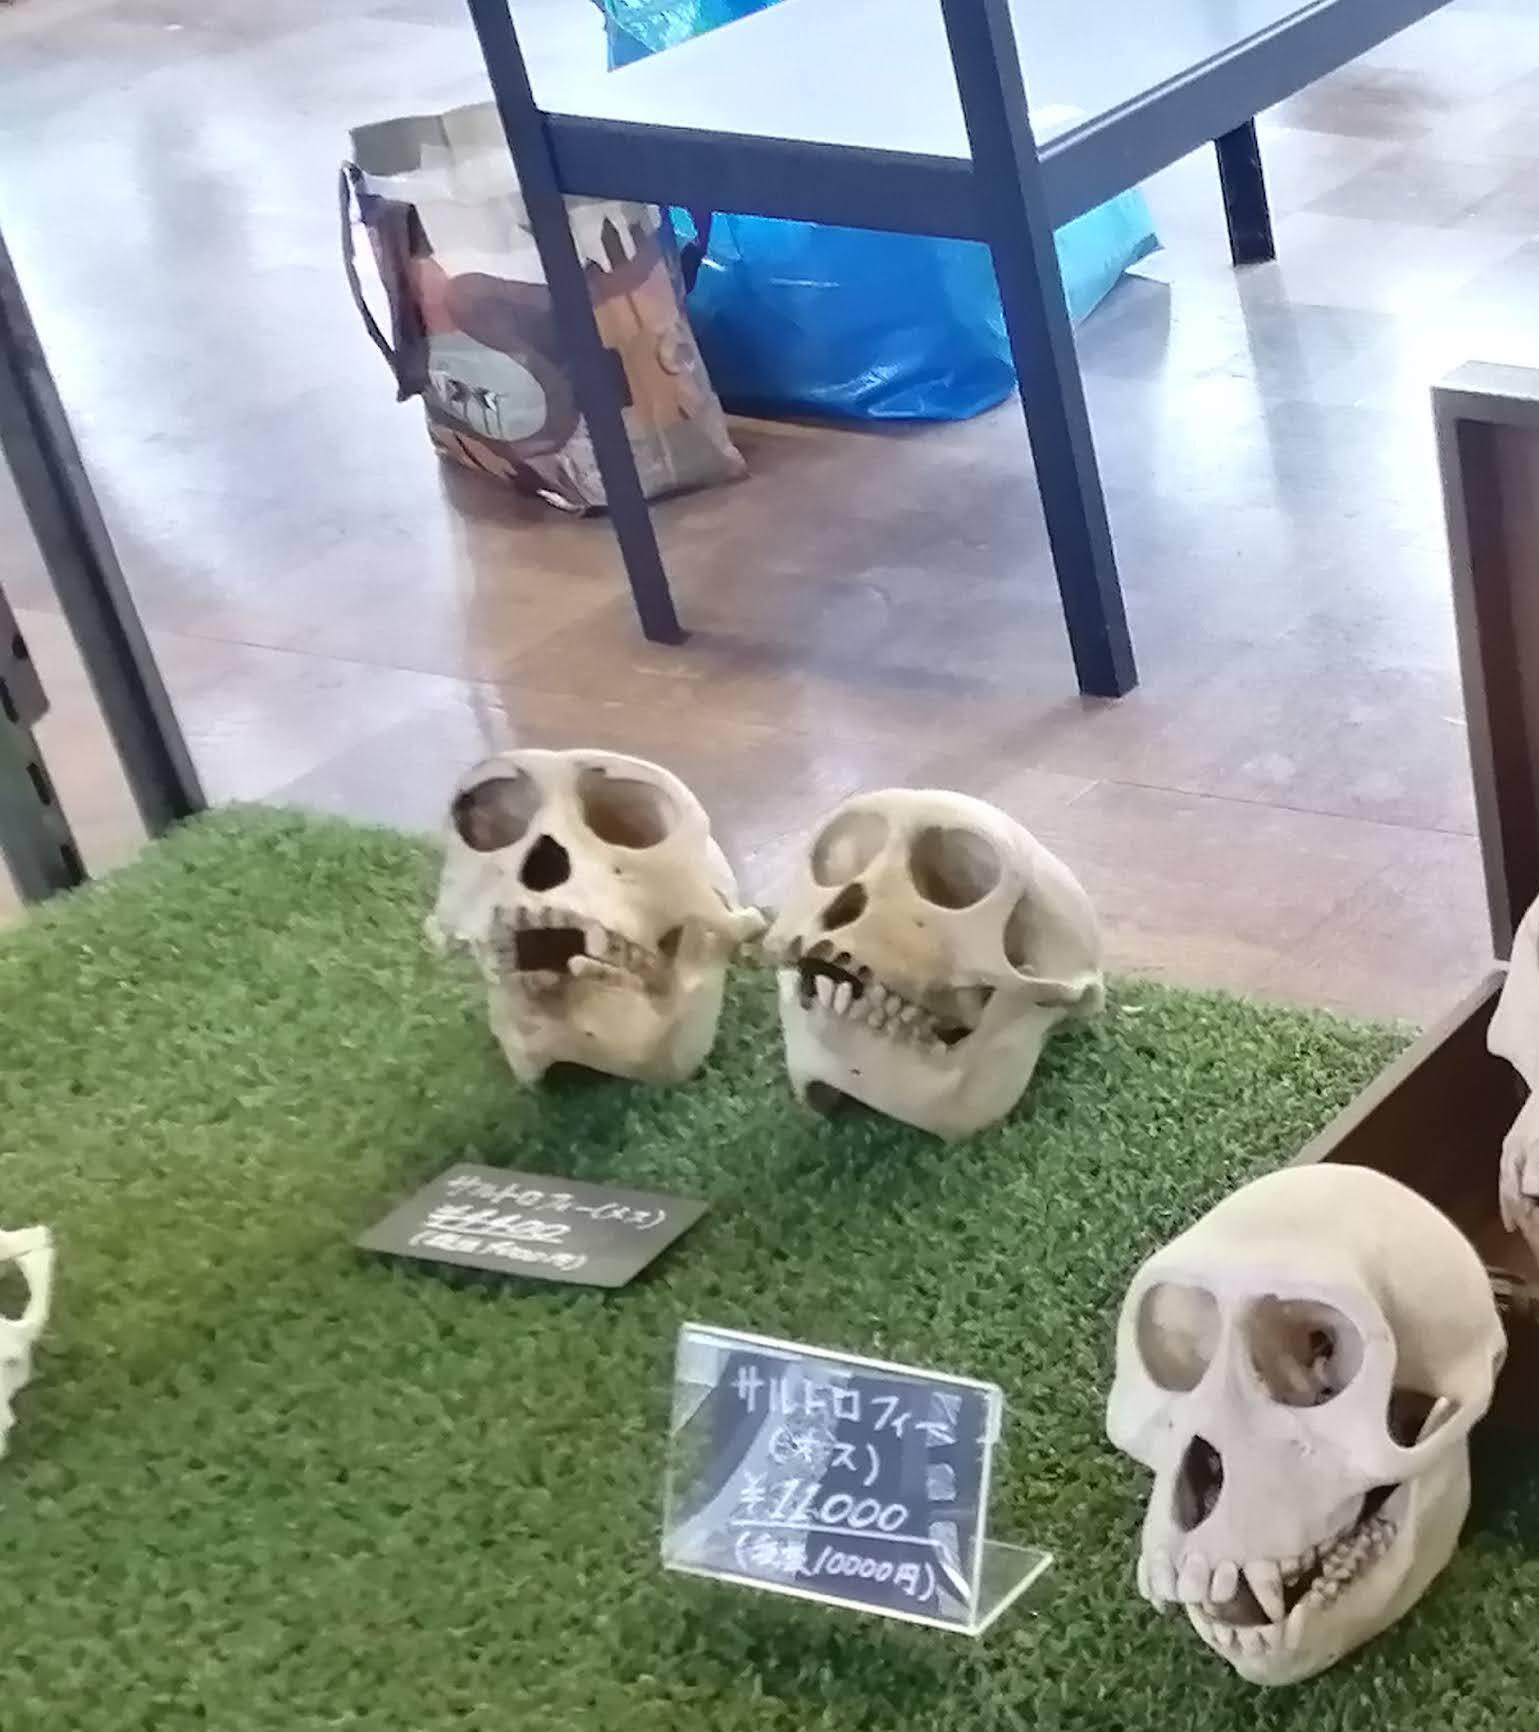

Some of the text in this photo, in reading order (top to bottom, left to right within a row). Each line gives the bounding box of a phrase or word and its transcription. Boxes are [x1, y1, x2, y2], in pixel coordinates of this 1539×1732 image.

[731, 1366, 955, 1444] サルトロフィー
